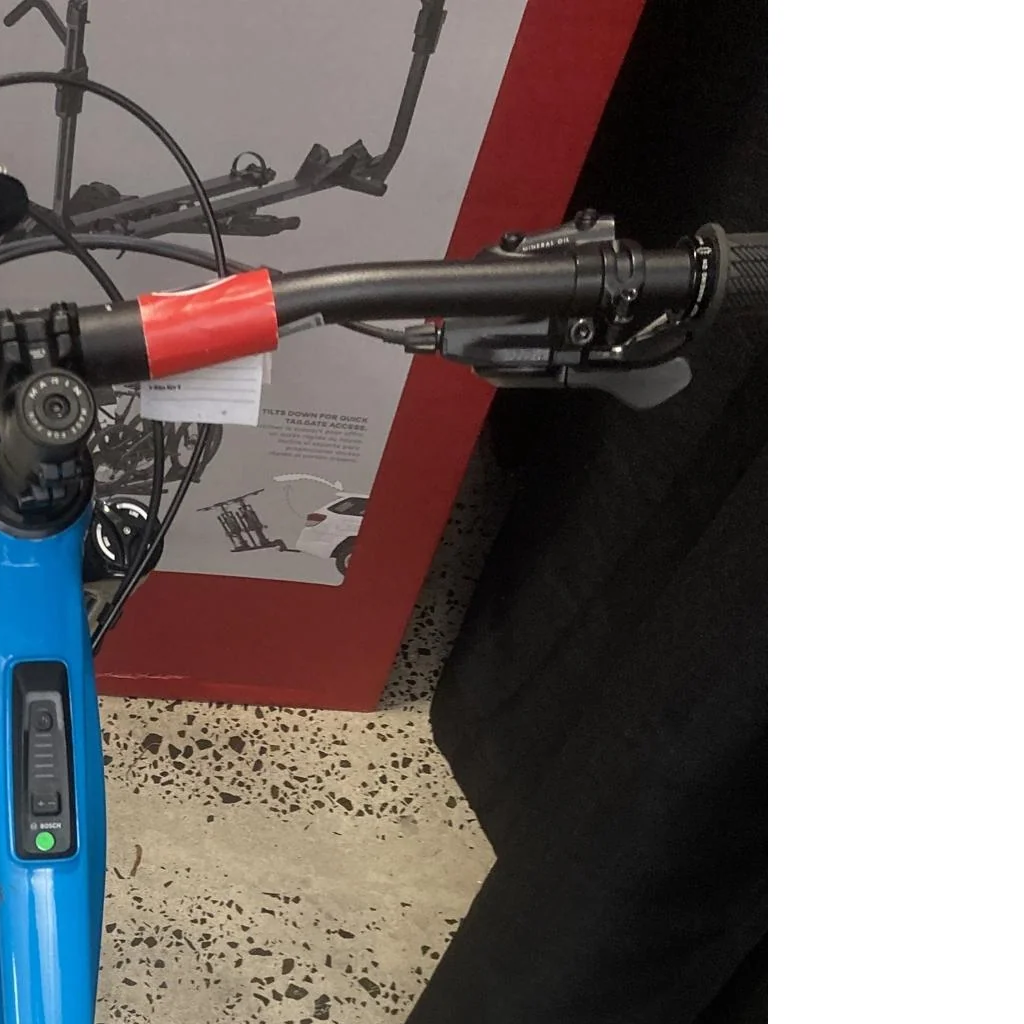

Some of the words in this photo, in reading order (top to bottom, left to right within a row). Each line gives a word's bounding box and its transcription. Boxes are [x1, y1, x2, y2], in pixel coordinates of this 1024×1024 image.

[522, 240, 554, 251] MINERAL
[557, 236, 569, 245] OIL
[262, 408, 286, 416] TILTS
[287, 410, 317, 419] DOWN
[319, 413, 338, 421] FOR
[339, 415, 369, 424] QUICK
[39, 821, 62, 830] BOSCH
